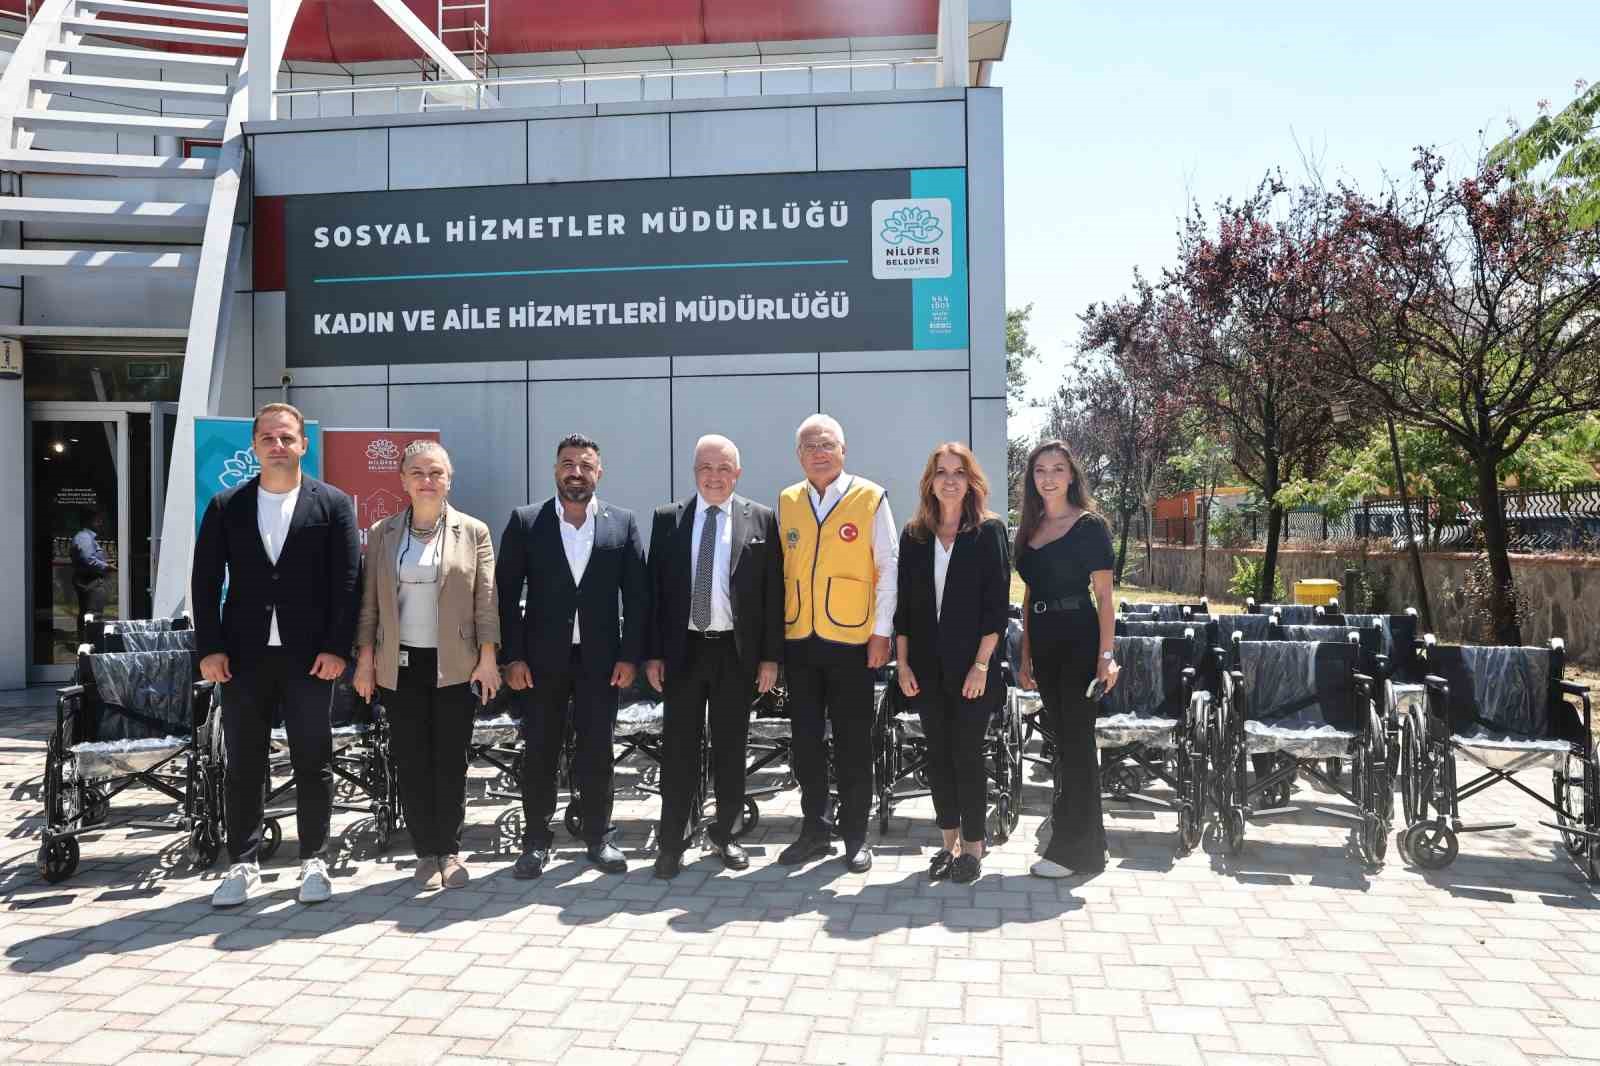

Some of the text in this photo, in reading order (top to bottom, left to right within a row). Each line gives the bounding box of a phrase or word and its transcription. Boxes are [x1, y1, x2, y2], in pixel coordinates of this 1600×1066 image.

[314, 199, 849, 248] SOSYAL HİZMETLER MÜDÜRLÜĞÜ
[886, 246, 940, 257] NİLÜFER
[886, 257, 939, 266] BELEDİYESİ
[314, 290, 849, 335] KADIN VE AİLE HİZMETLERİ MÜDÜRLÜĞÜ
